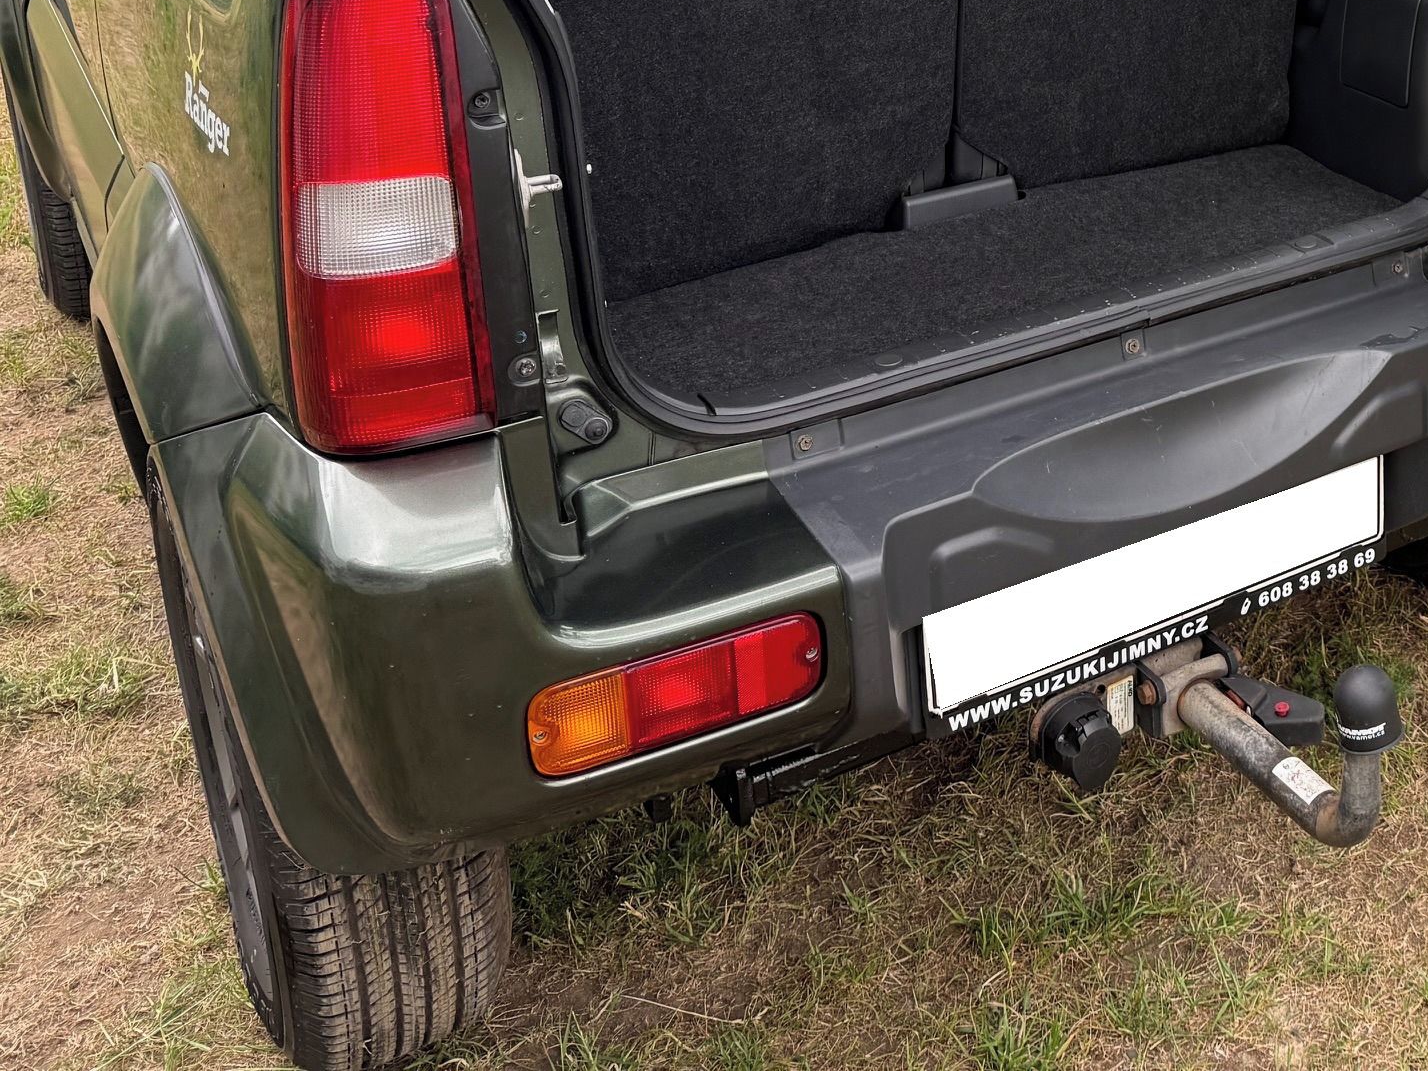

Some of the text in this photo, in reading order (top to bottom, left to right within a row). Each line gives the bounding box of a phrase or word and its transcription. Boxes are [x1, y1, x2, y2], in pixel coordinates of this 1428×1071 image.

[185, 72, 230, 156] Ranger
[1258, 548, 1376, 607] 608 38 38 69
[949, 615, 1208, 731] WWW.SUZUKIJIMNY.CZ
